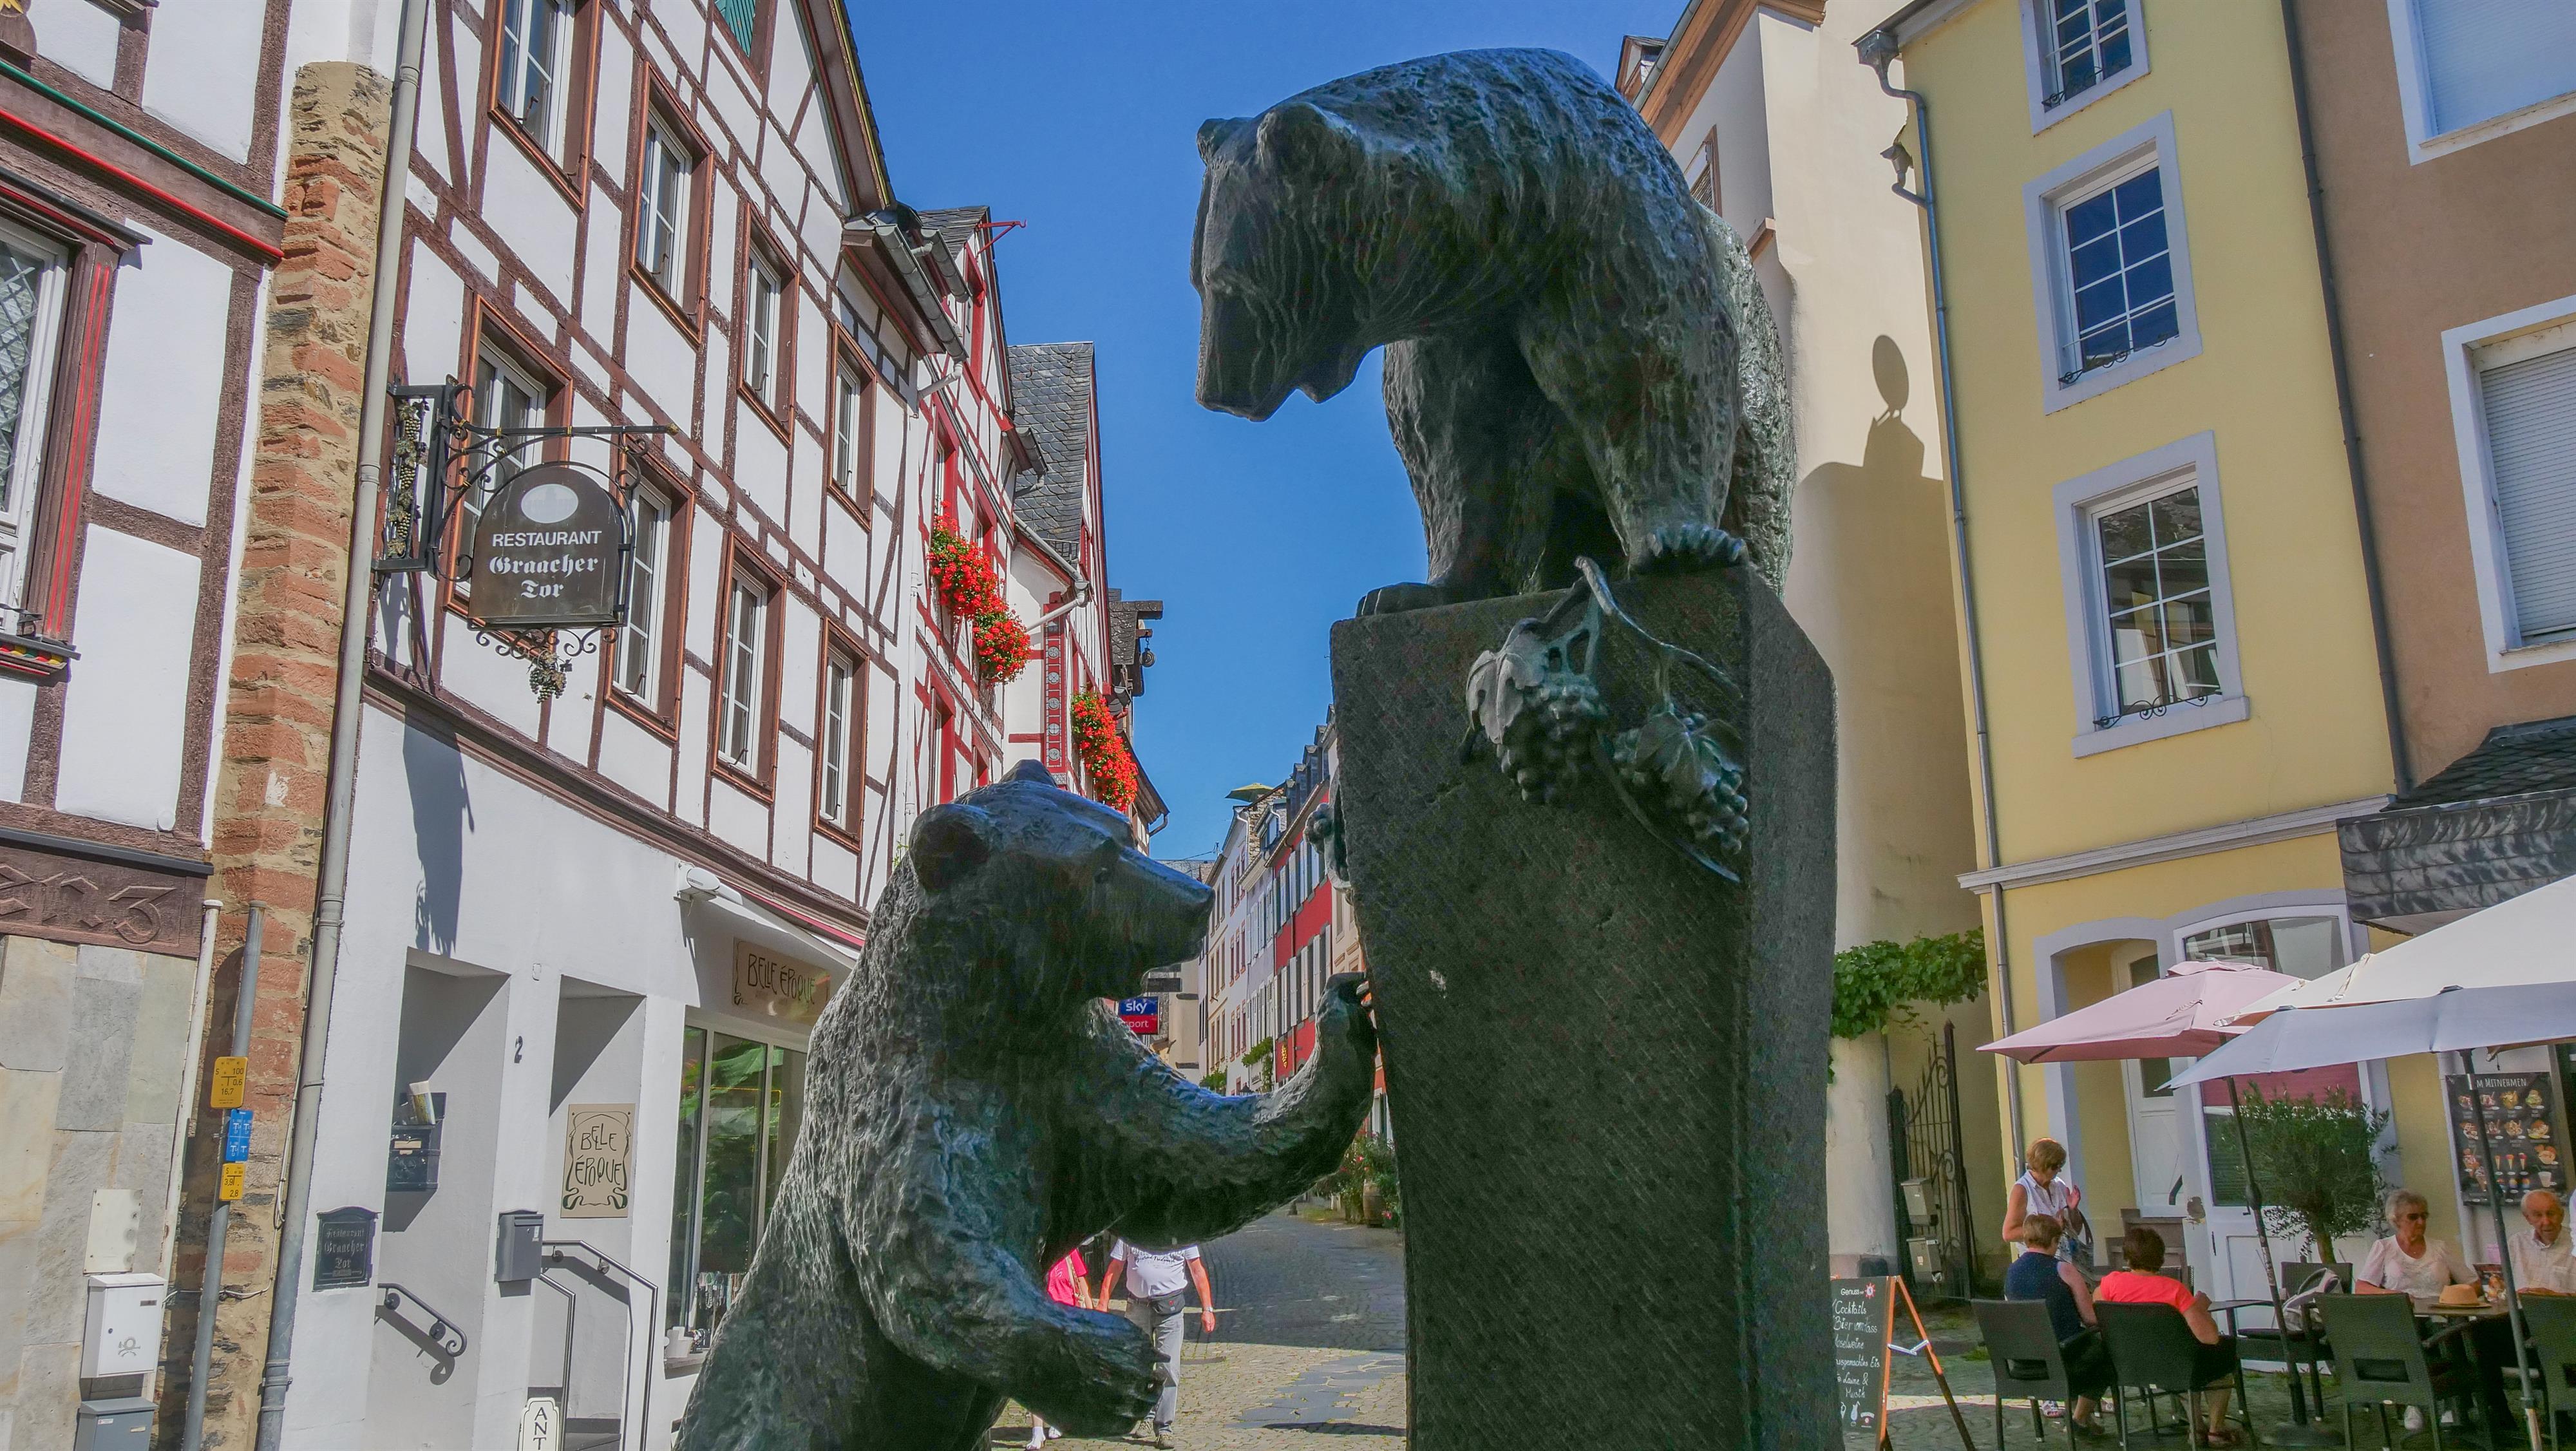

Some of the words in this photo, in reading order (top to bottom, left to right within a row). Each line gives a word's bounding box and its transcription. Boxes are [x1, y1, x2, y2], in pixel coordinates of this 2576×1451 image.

[492, 530, 602, 547] RESTAURANT
[489, 554, 599, 578] Graacher
[520, 580, 564, 598] Tor
[747, 953, 777, 995] BELLE
[779, 965, 815, 1005] ÉPOQUE
[1126, 1000, 1147, 1014] sky
[514, 1036, 523, 1063] 2
[2476, 1079, 2483, 1088] M
[2485, 1077, 2526, 1088] MITNEHMEN
[581, 1123, 617, 1151] BELLE
[575, 1155, 621, 1187] ÉPOQUE
[325, 1240, 365, 1257] Graacher
[335, 1257, 352, 1269] Tor
[1835, 1300, 1867, 1314] Cocktails
[1833, 1316, 1853, 1331] Bier
[1870, 1356, 1880, 1367] Eis
[1862, 1372, 1869, 1385] &
